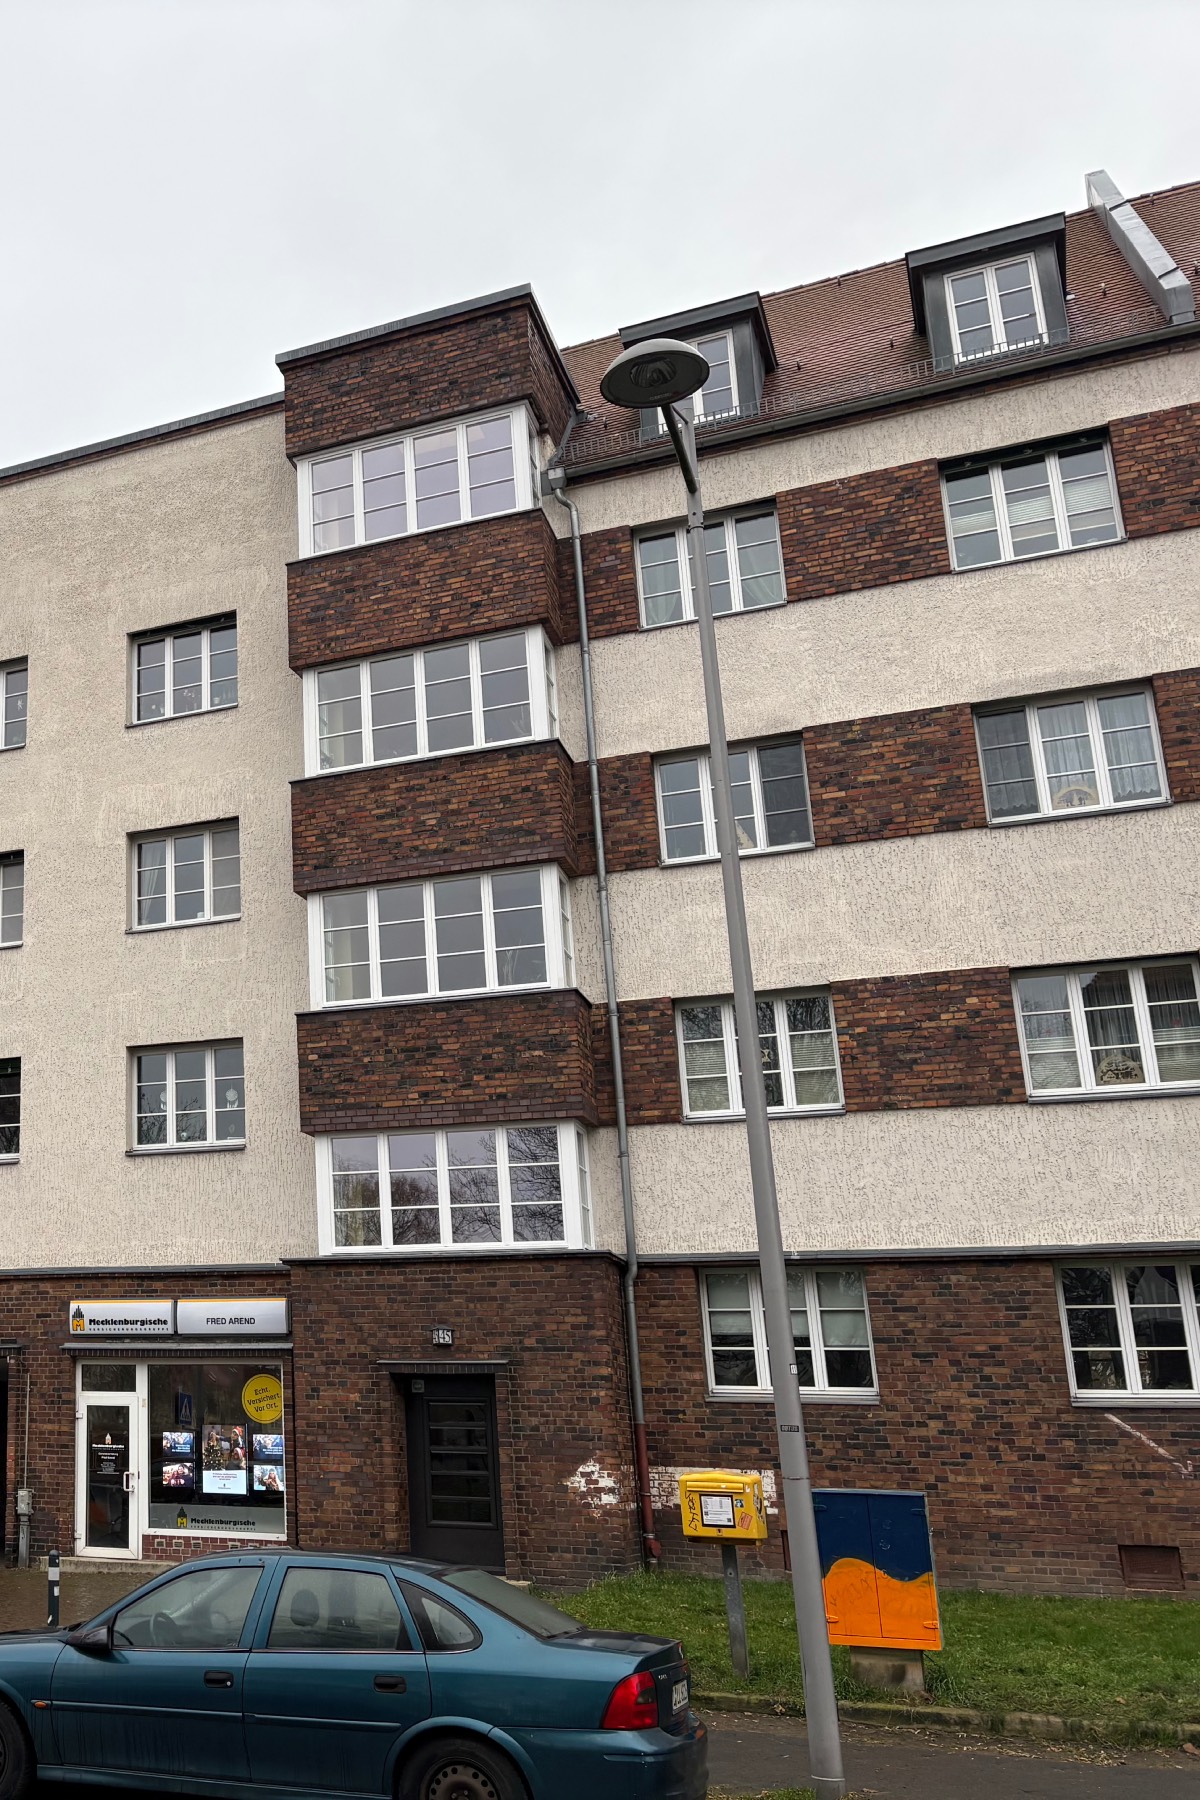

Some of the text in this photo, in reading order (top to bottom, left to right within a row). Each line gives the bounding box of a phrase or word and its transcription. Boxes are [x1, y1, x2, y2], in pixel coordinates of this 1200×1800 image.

[89, 1318, 168, 1326] Mecklenburgische
[228, 1317, 255, 1325] AREND
[439, 1330, 451, 1343] 45
[254, 1387, 270, 1395] Echt.
[247, 1393, 281, 1405] Versichert.
[266, 1402, 278, 1410] Ort.
[191, 1518, 256, 1526] Mecklenburgische
